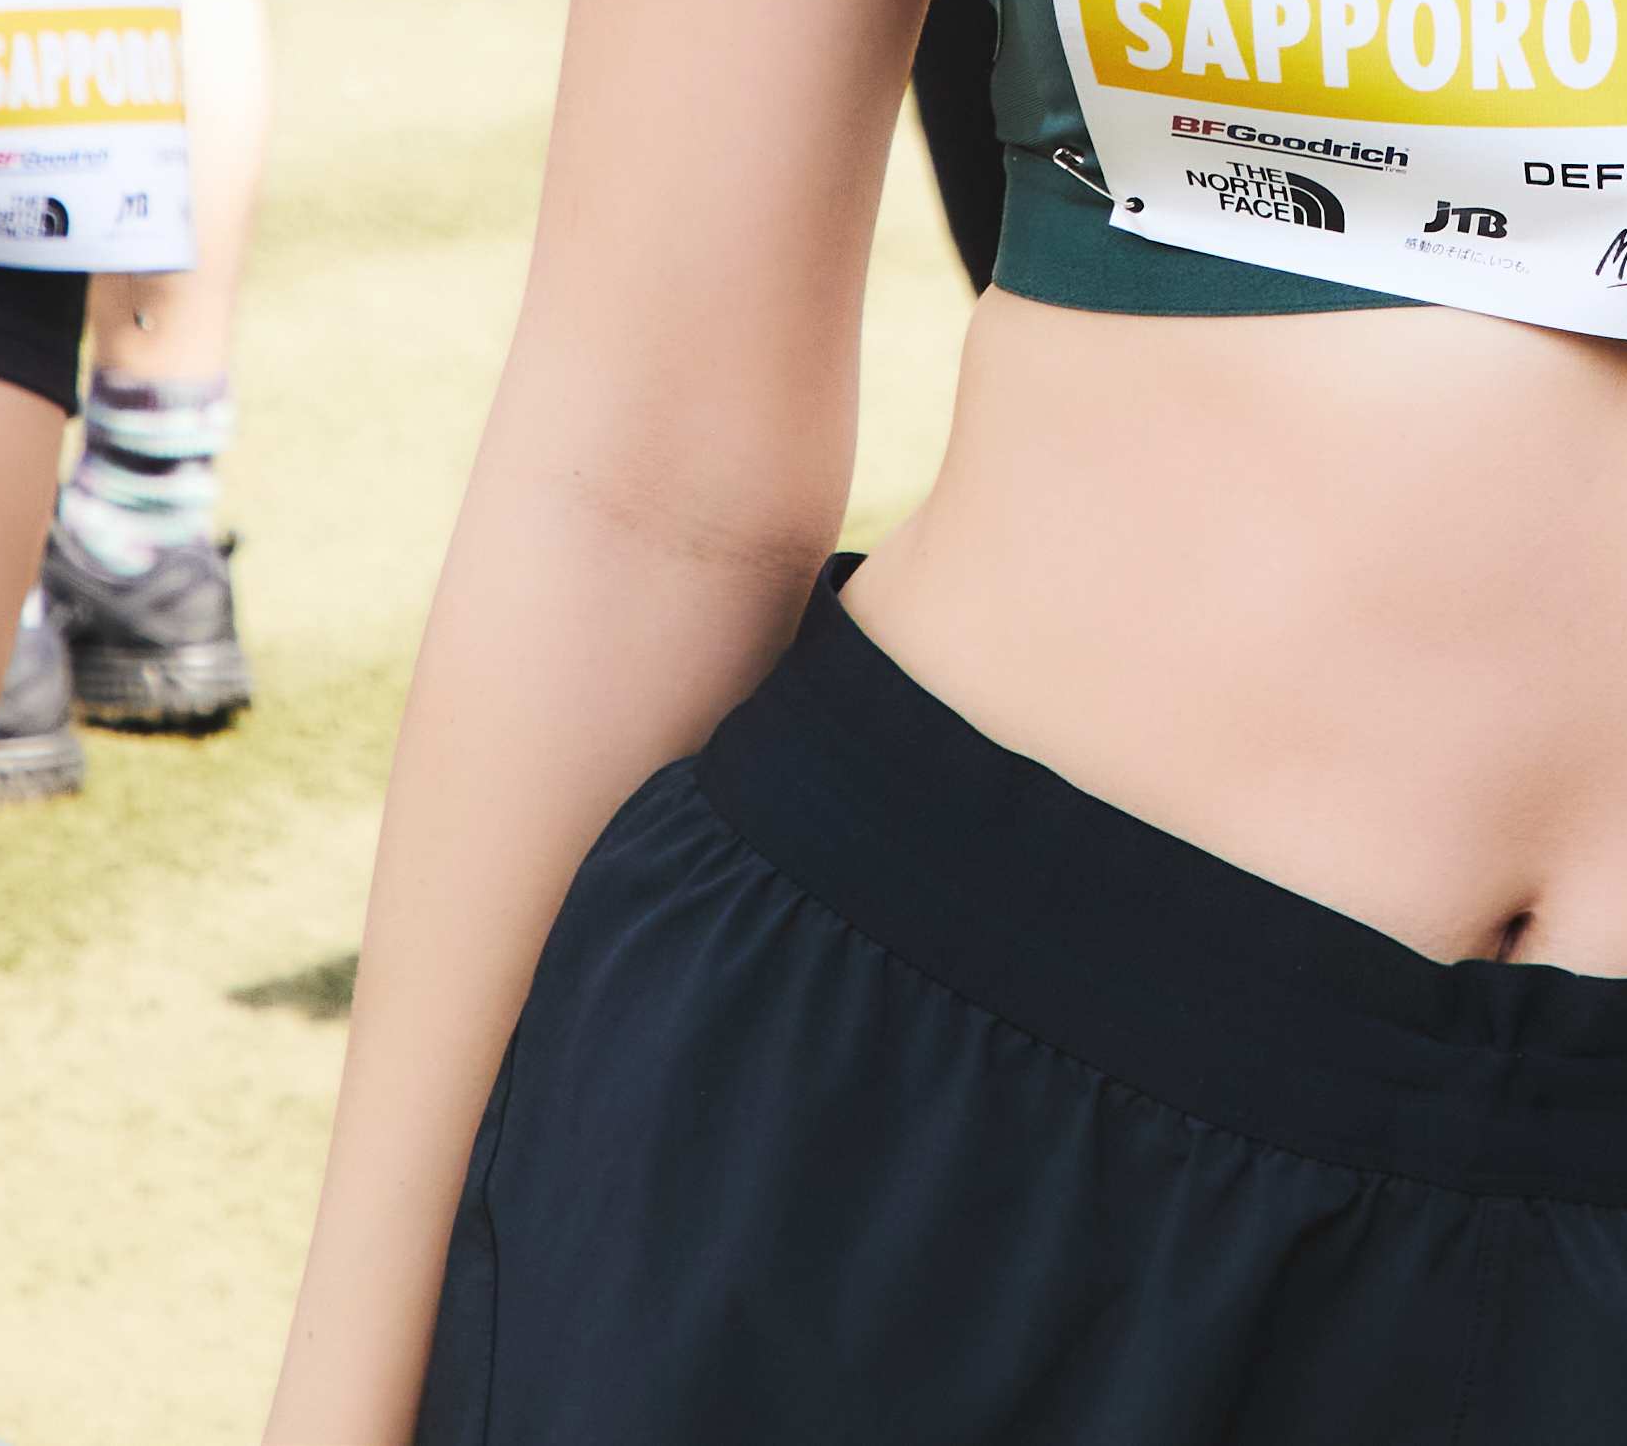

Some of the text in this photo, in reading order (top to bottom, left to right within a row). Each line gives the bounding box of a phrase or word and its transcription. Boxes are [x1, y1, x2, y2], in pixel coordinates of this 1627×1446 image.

[1172, 115, 1409, 167] BFGoodrich
[1185, 169, 1289, 203] NORTH
[1226, 160, 1286, 184] THE
[1219, 193, 1292, 224] FACE
[1423, 201, 1508, 239] JTB
